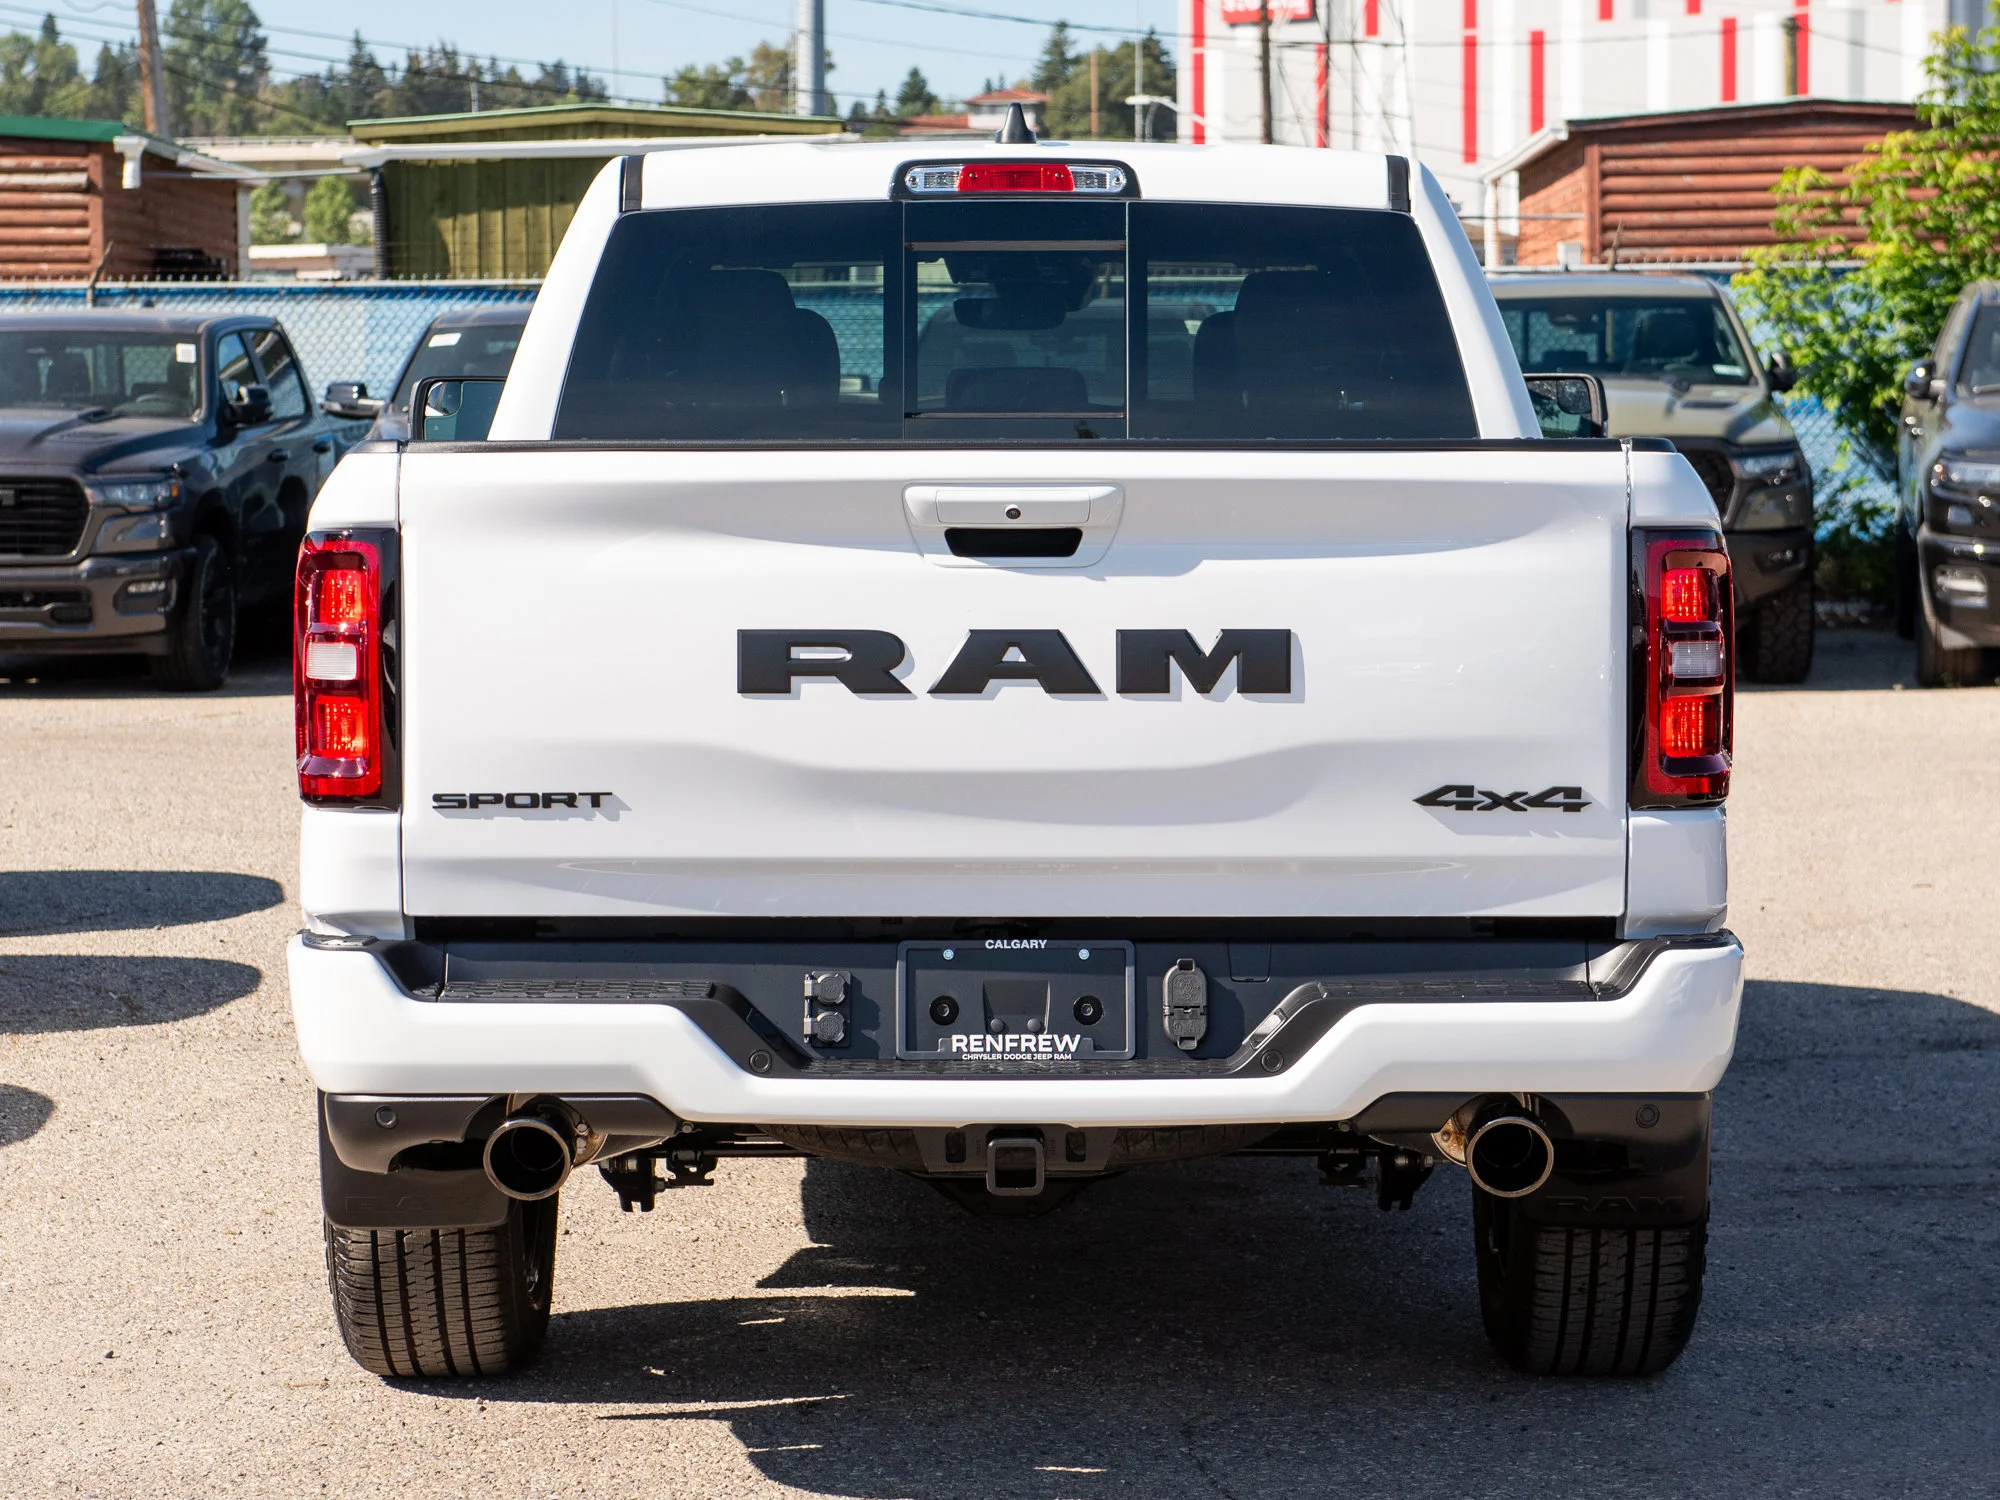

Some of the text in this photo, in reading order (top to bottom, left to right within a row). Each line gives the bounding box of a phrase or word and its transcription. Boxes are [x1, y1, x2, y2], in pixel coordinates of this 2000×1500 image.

[737, 629, 1292, 694] RAM
[432, 792, 613, 809] SPORT
[1412, 785, 1592, 812] 4x4
[985, 939, 1047, 949] CALGARY
[951, 1034, 1080, 1053] RENFREW
